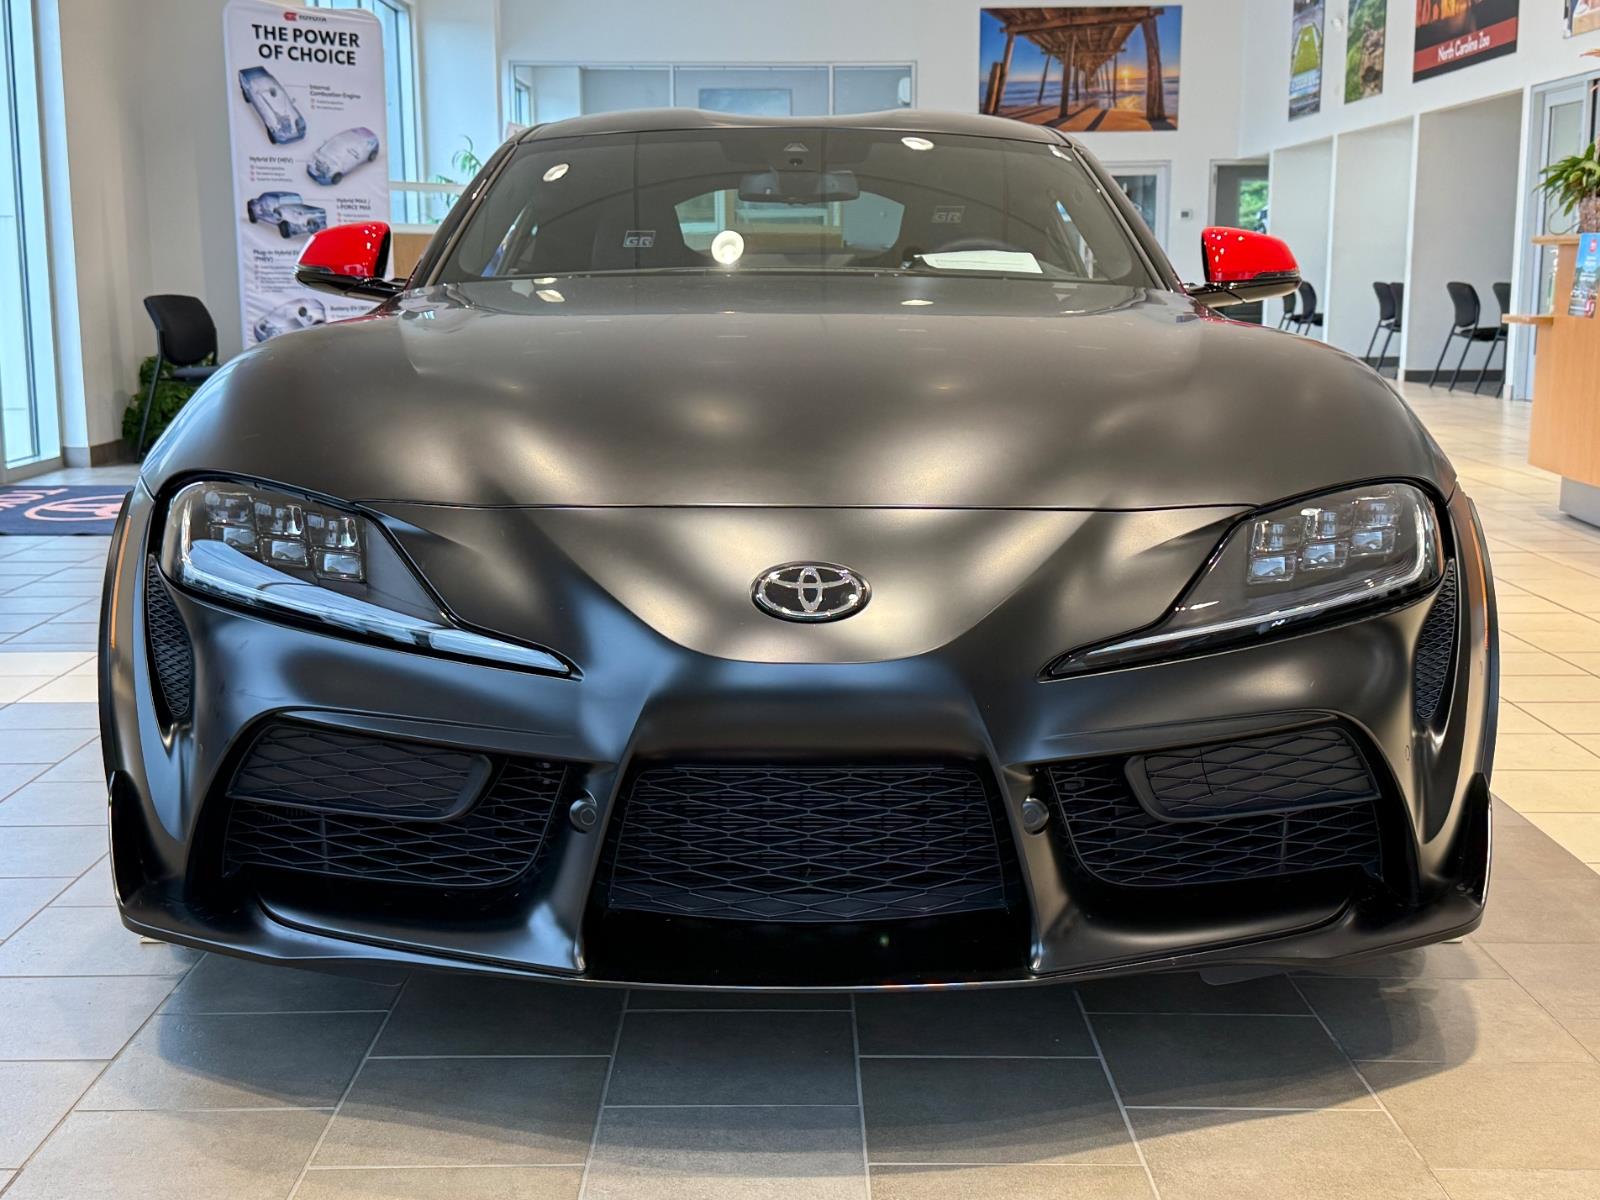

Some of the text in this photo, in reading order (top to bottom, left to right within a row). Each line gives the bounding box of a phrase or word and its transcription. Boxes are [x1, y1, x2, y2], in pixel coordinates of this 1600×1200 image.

[298, 15, 327, 23] TOYOTA
[251, 24, 360, 48] THE POWER
[258, 43, 357, 66] OF CHOICE
[1438, 31, 1490, 62] North Carolina Zoo
[930, 211, 962, 224] GR
[624, 235, 654, 248] GR
